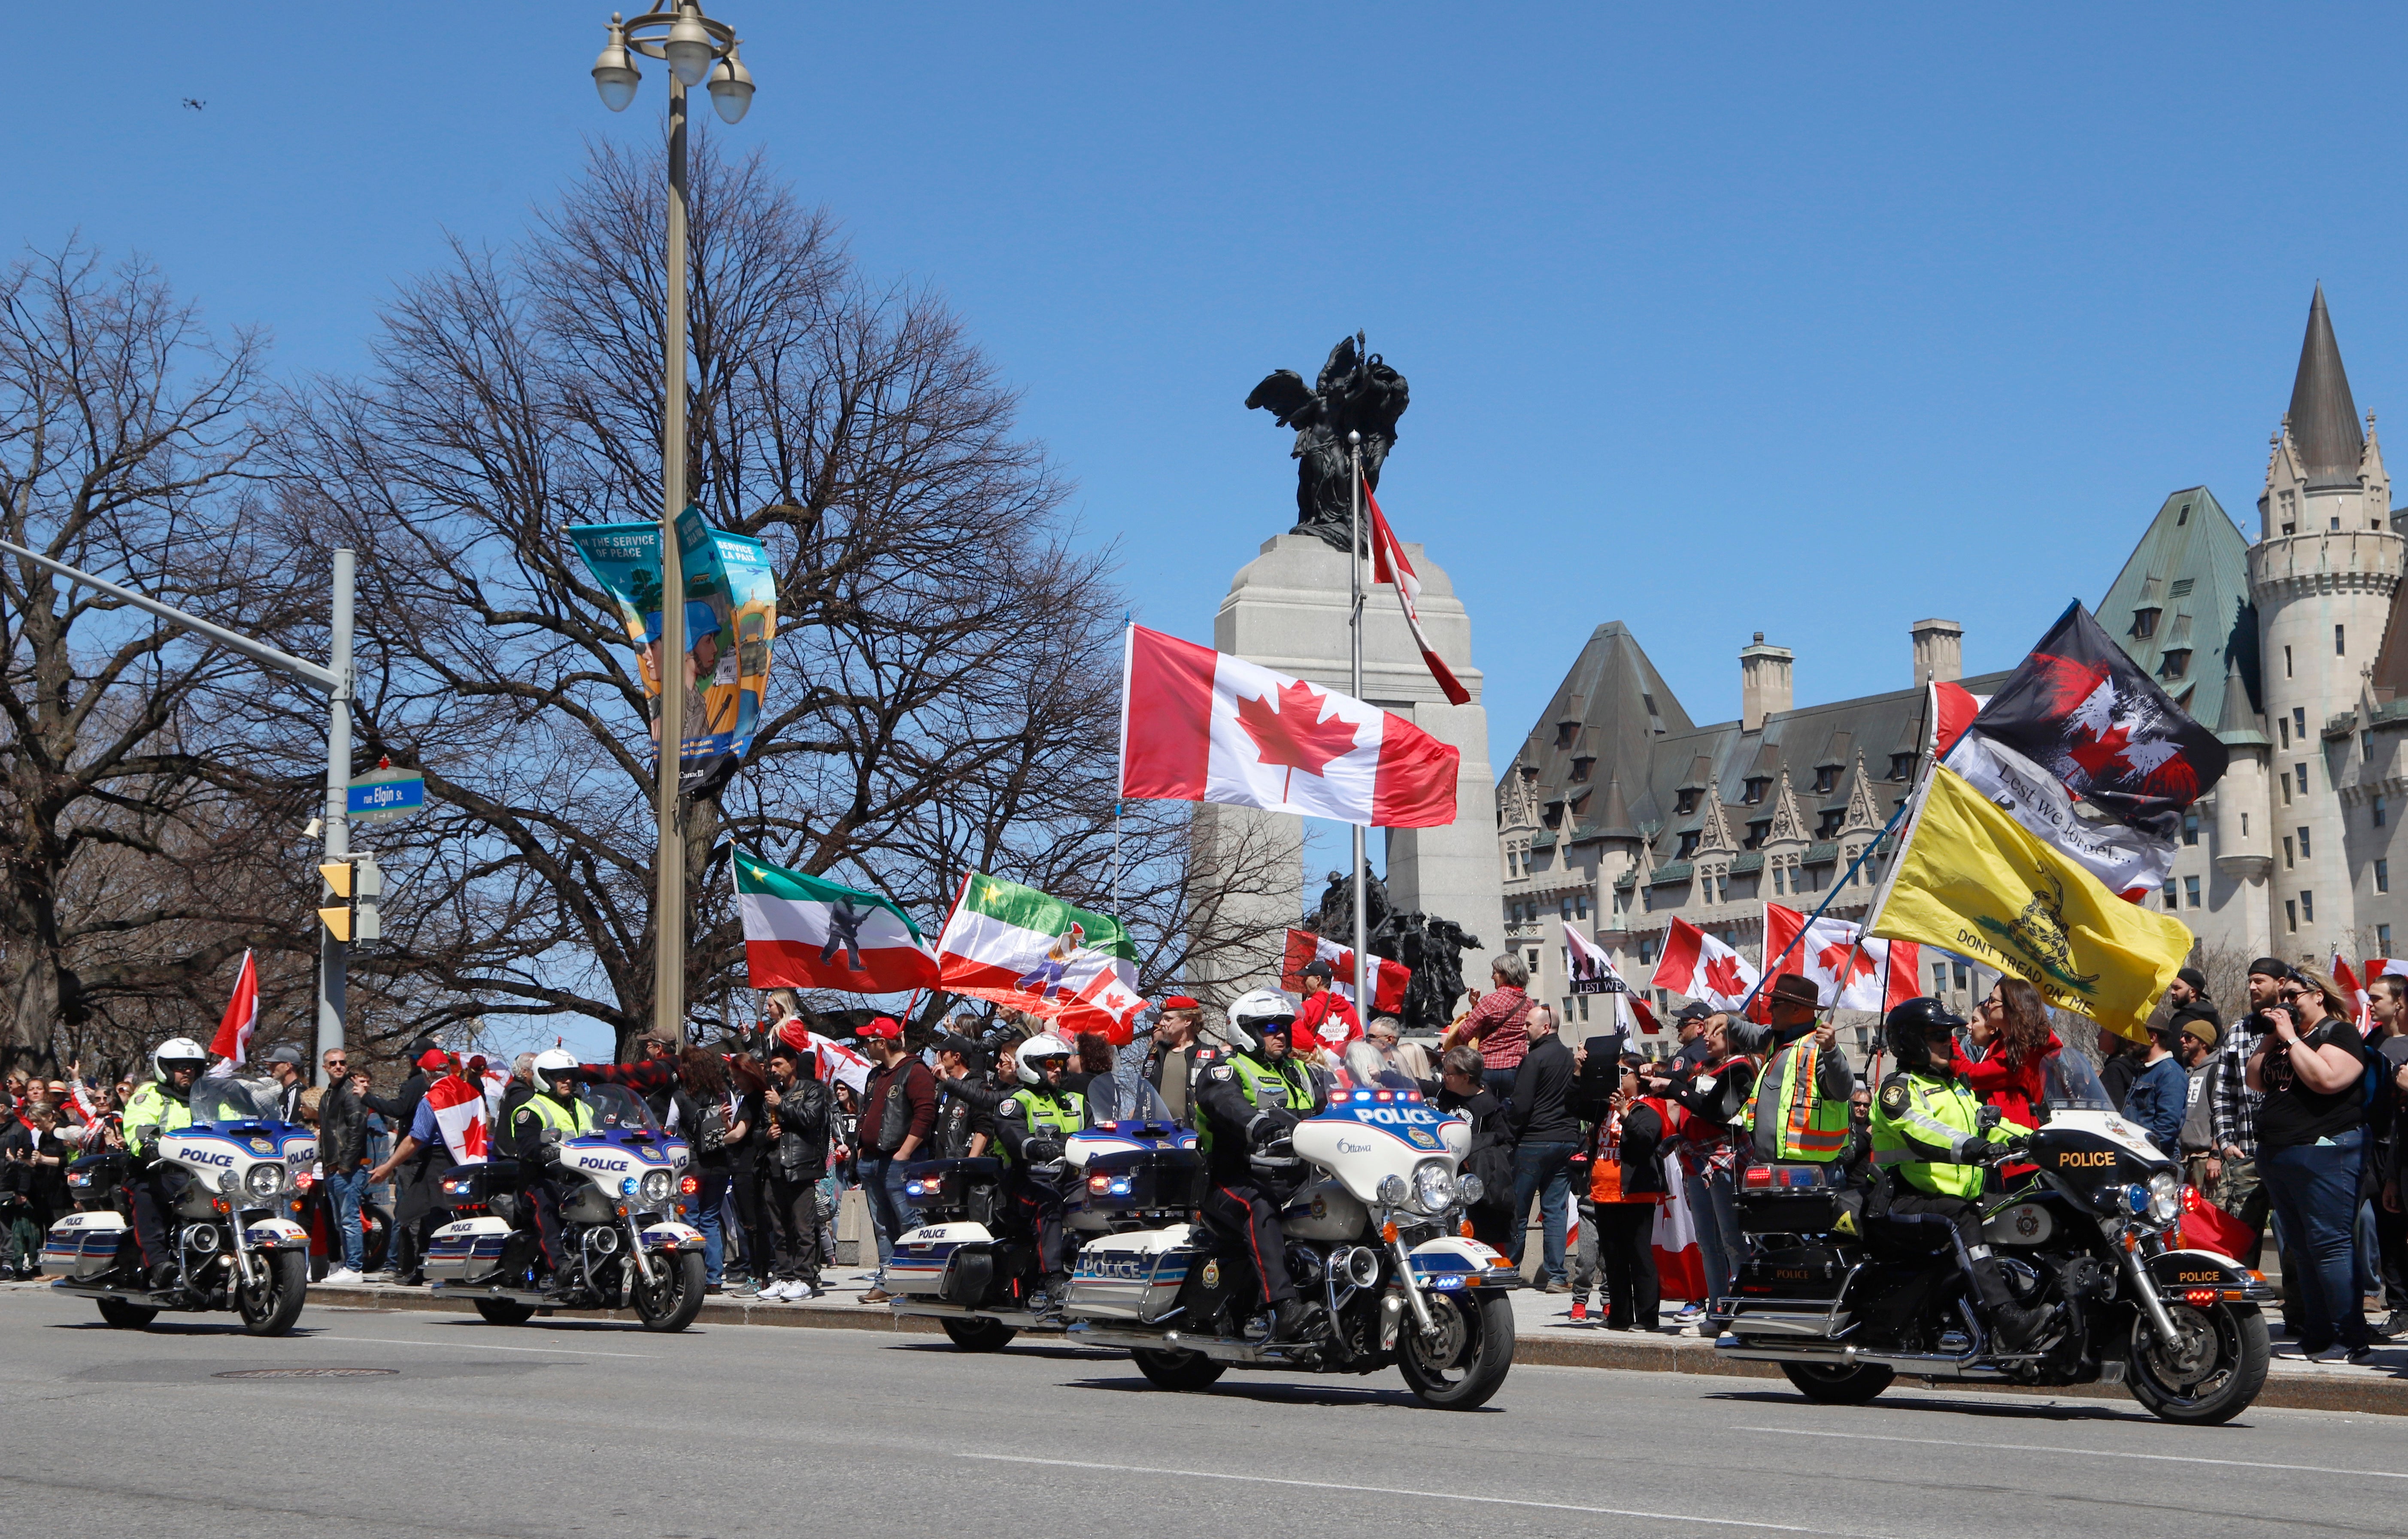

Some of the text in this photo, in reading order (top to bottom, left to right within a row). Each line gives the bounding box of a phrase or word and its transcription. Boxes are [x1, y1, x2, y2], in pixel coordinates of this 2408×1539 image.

[591, 537, 610, 547] THE
[613, 535, 655, 547] SERVICE
[716, 540, 754, 555] SERVICE
[596, 547, 642, 557] OF PEACE
[722, 550, 757, 562] LA PAIX
[690, 739, 713, 747] Balkans
[690, 747, 714, 756] Balkans
[679, 769, 704, 779] Canada
[364, 795, 373, 804] rue
[374, 786, 394, 807] Elgin
[1997, 764, 2036, 803] Lest
[2038, 798, 2063, 825] we
[1956, 929, 2095, 1015] DONT TREAD ON ME
[1578, 982, 1601, 994] LEST
[1603, 980, 1622, 991] WE
[1353, 1108, 1439, 1125] POLICE
[1337, 1138, 1371, 1154] Ottawa
[179, 1147, 235, 1167] POLICE
[2059, 1151, 2117, 1167] POLICE
[579, 1157, 629, 1171] POLICE
[64, 1217, 85, 1226] POLICE
[450, 1223, 474, 1233] POLICE
[918, 1229, 947, 1239] POLICE
[1083, 1259, 1141, 1279] POLICE
[1776, 1269, 1810, 1279] POLICE
[2179, 1271, 2220, 1282] POLICE
